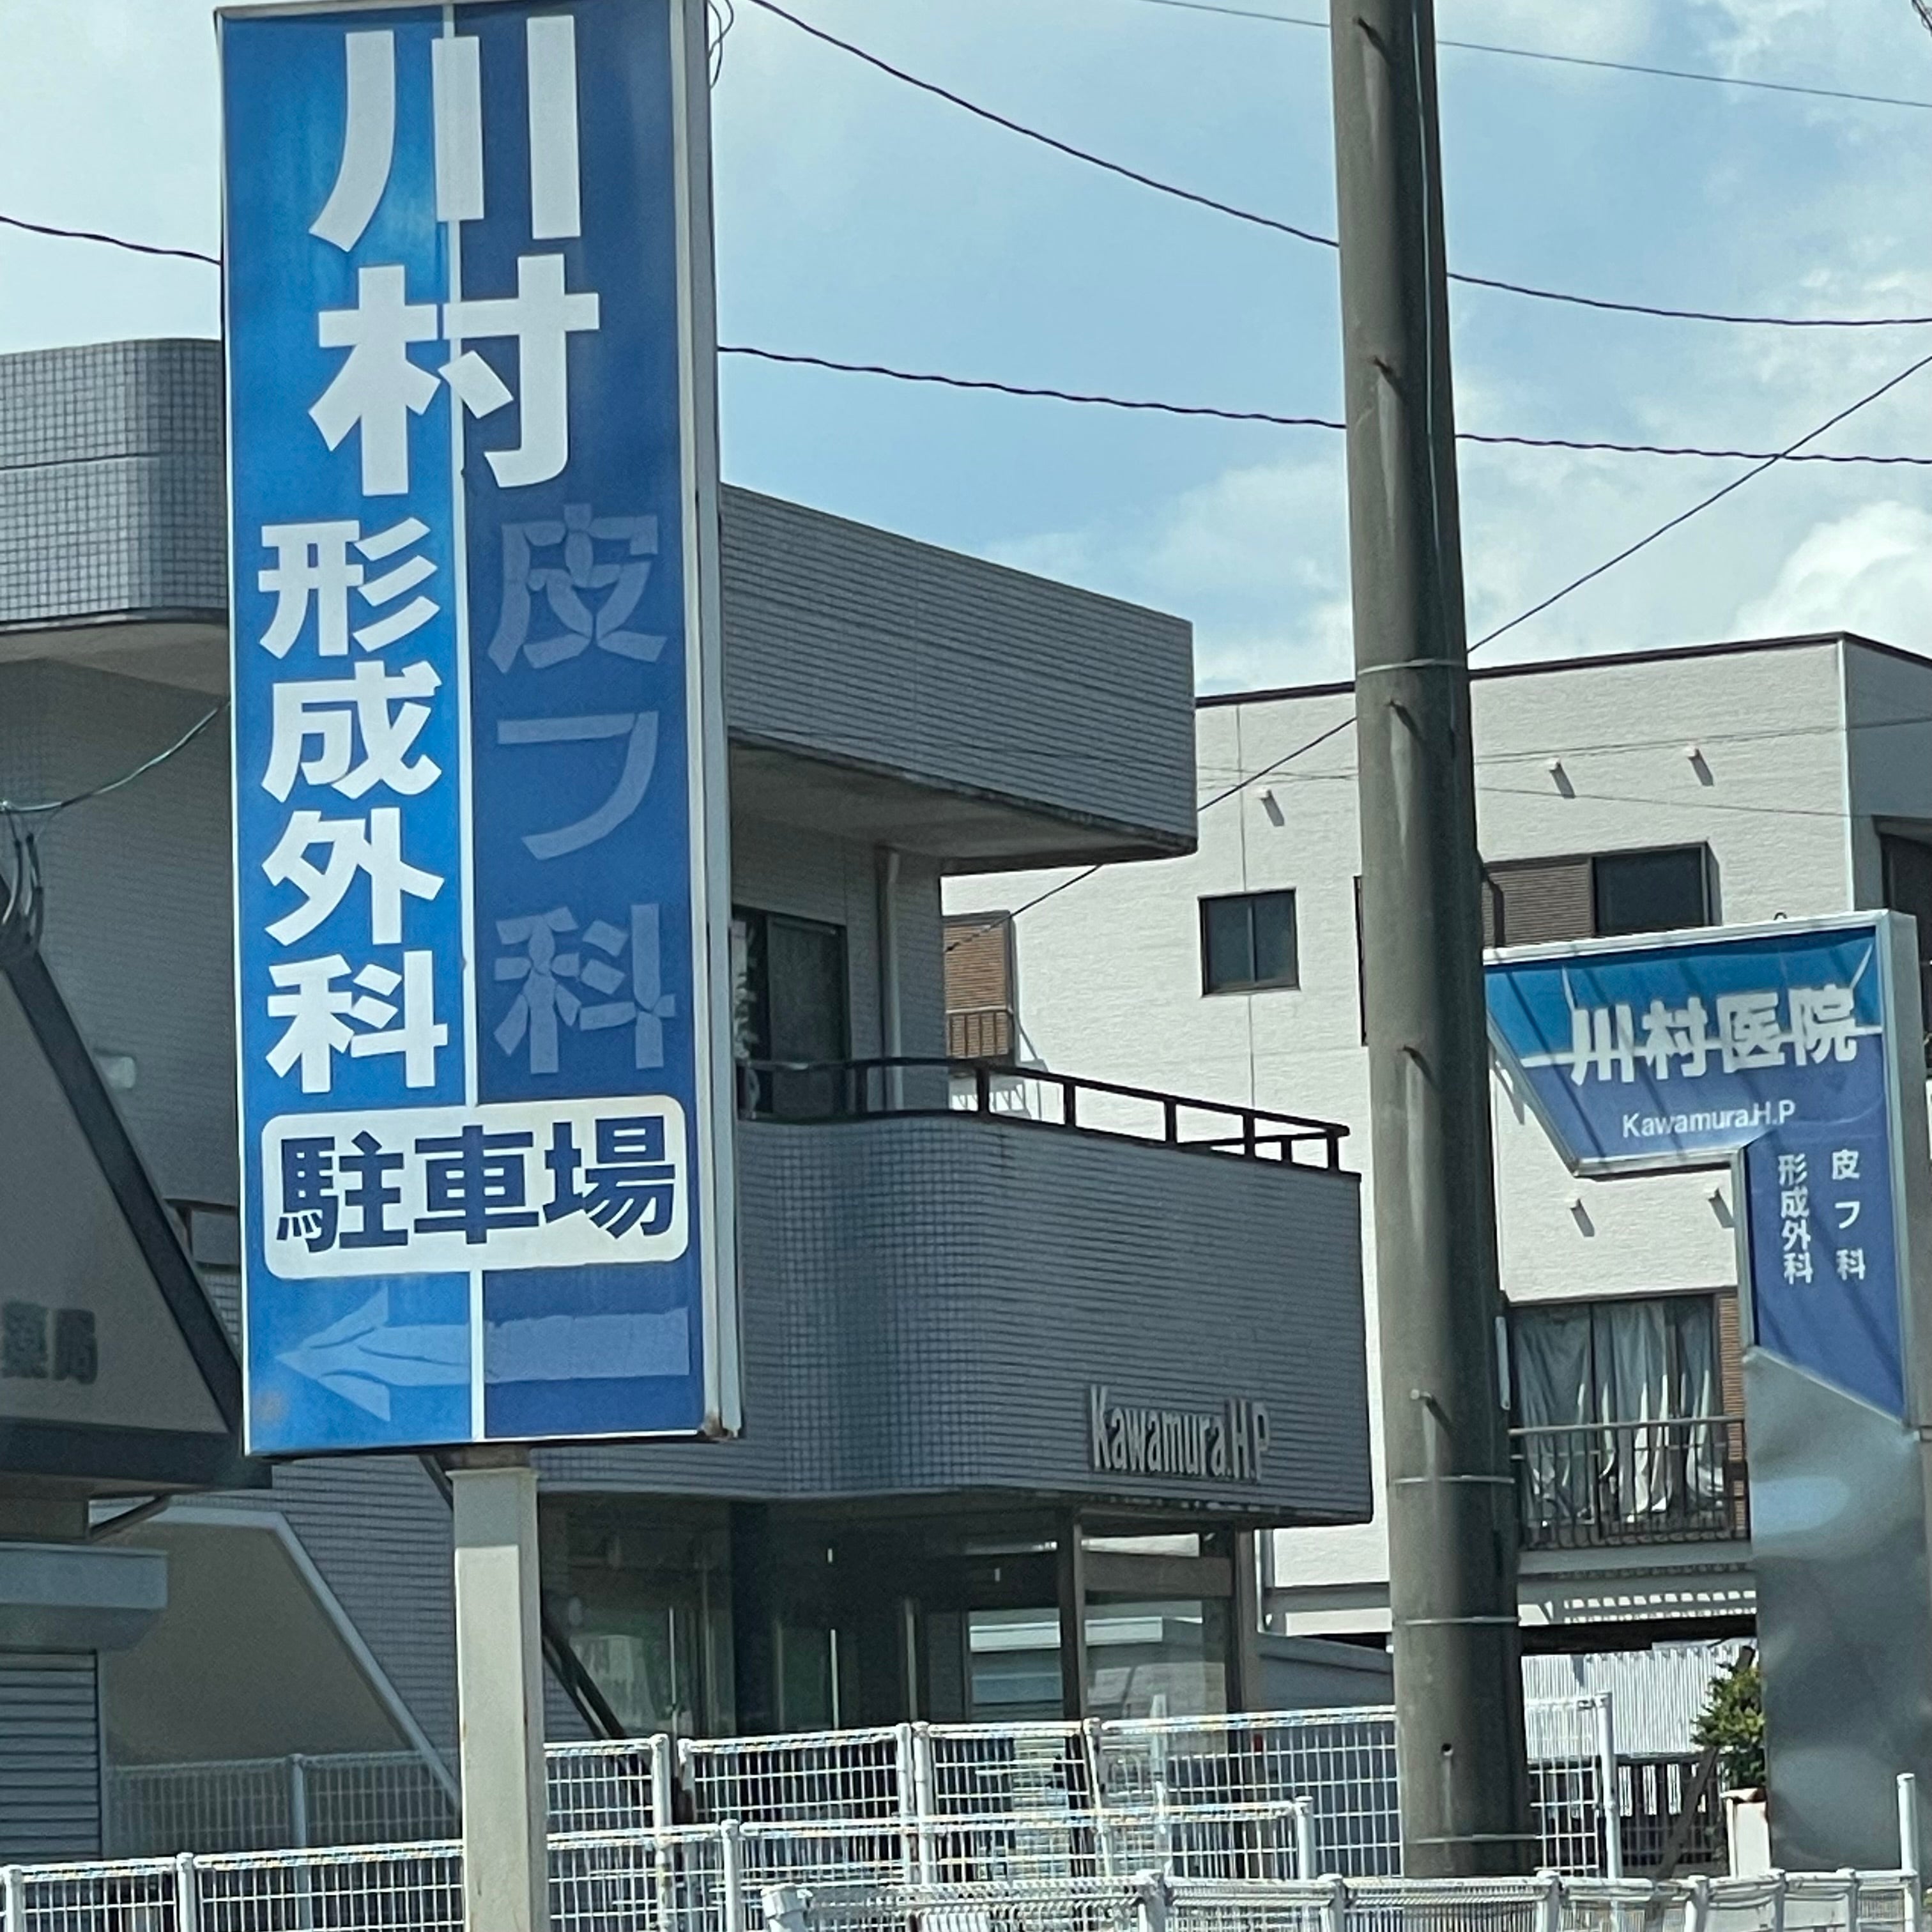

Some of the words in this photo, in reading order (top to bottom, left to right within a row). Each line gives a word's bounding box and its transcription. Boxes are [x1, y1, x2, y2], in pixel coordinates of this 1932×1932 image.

[309, 15, 600, 496] 川村
[258, 518, 448, 1093] 形成外科
[487, 504, 675, 1074] 皮フ科
[1570, 984, 1857, 1085] 川村医院
[276, 1116, 675, 1253] 駐車場
[1778, 1153, 1813, 1285] 形成外科
[1832, 1149, 1866, 1280] 皮フ科
